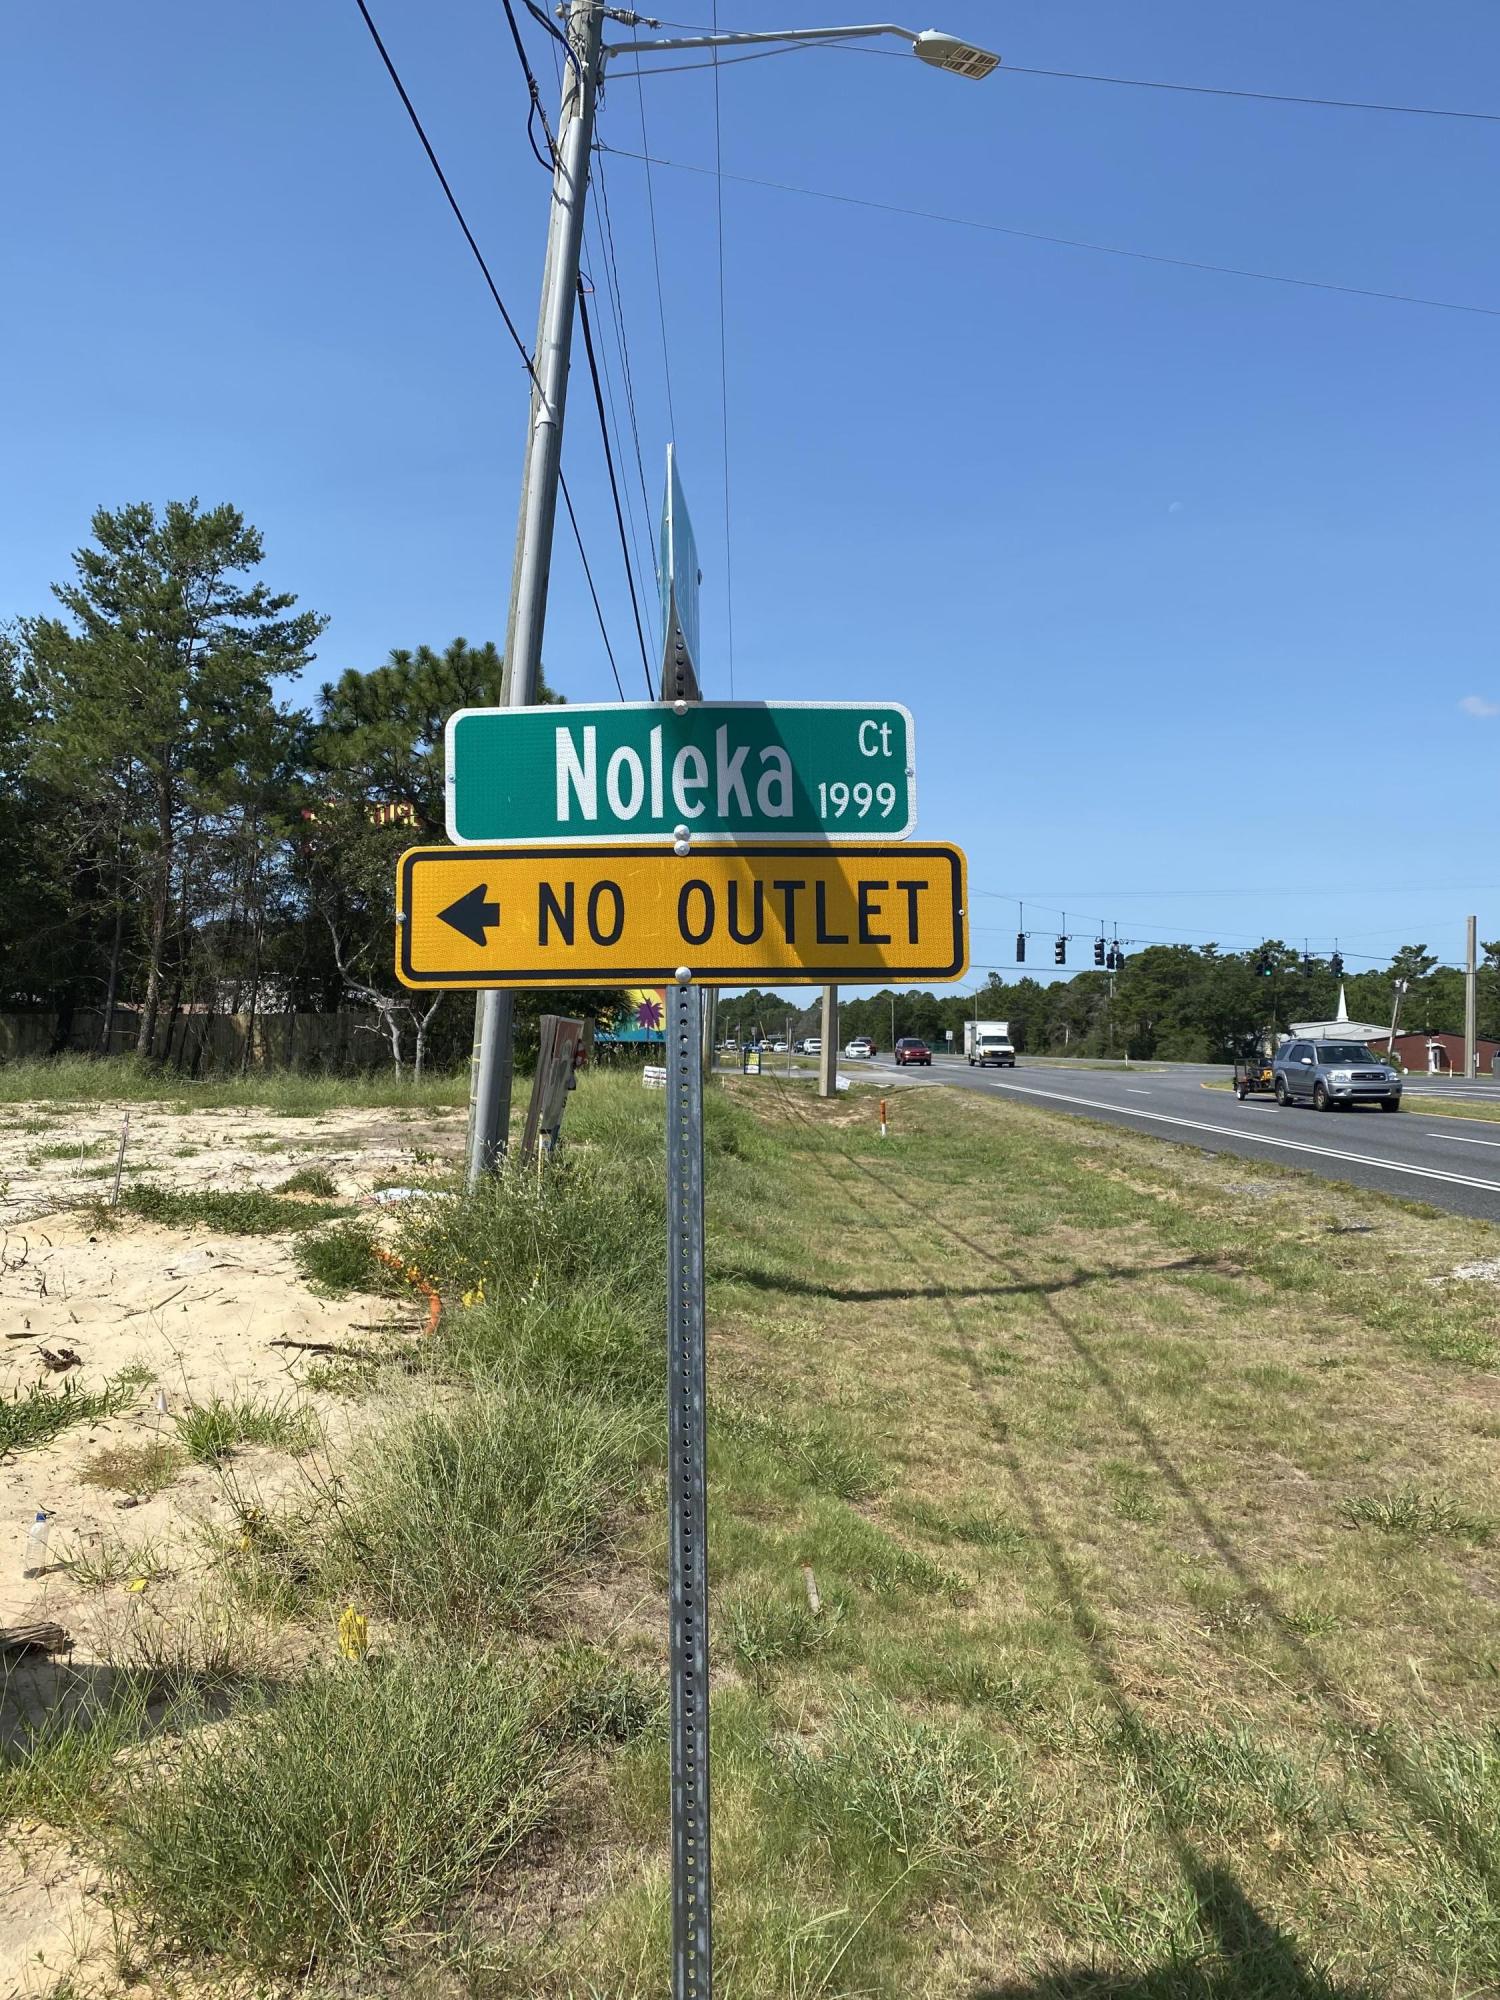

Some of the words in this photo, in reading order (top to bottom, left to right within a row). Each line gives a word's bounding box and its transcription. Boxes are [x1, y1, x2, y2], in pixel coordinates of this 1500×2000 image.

[858, 719, 893, 757] Ct
[555, 724, 793, 822] Noleka
[818, 782, 897, 819] 1999
[538, 880, 625, 946] NO
[677, 879, 929, 946] OUTLET
